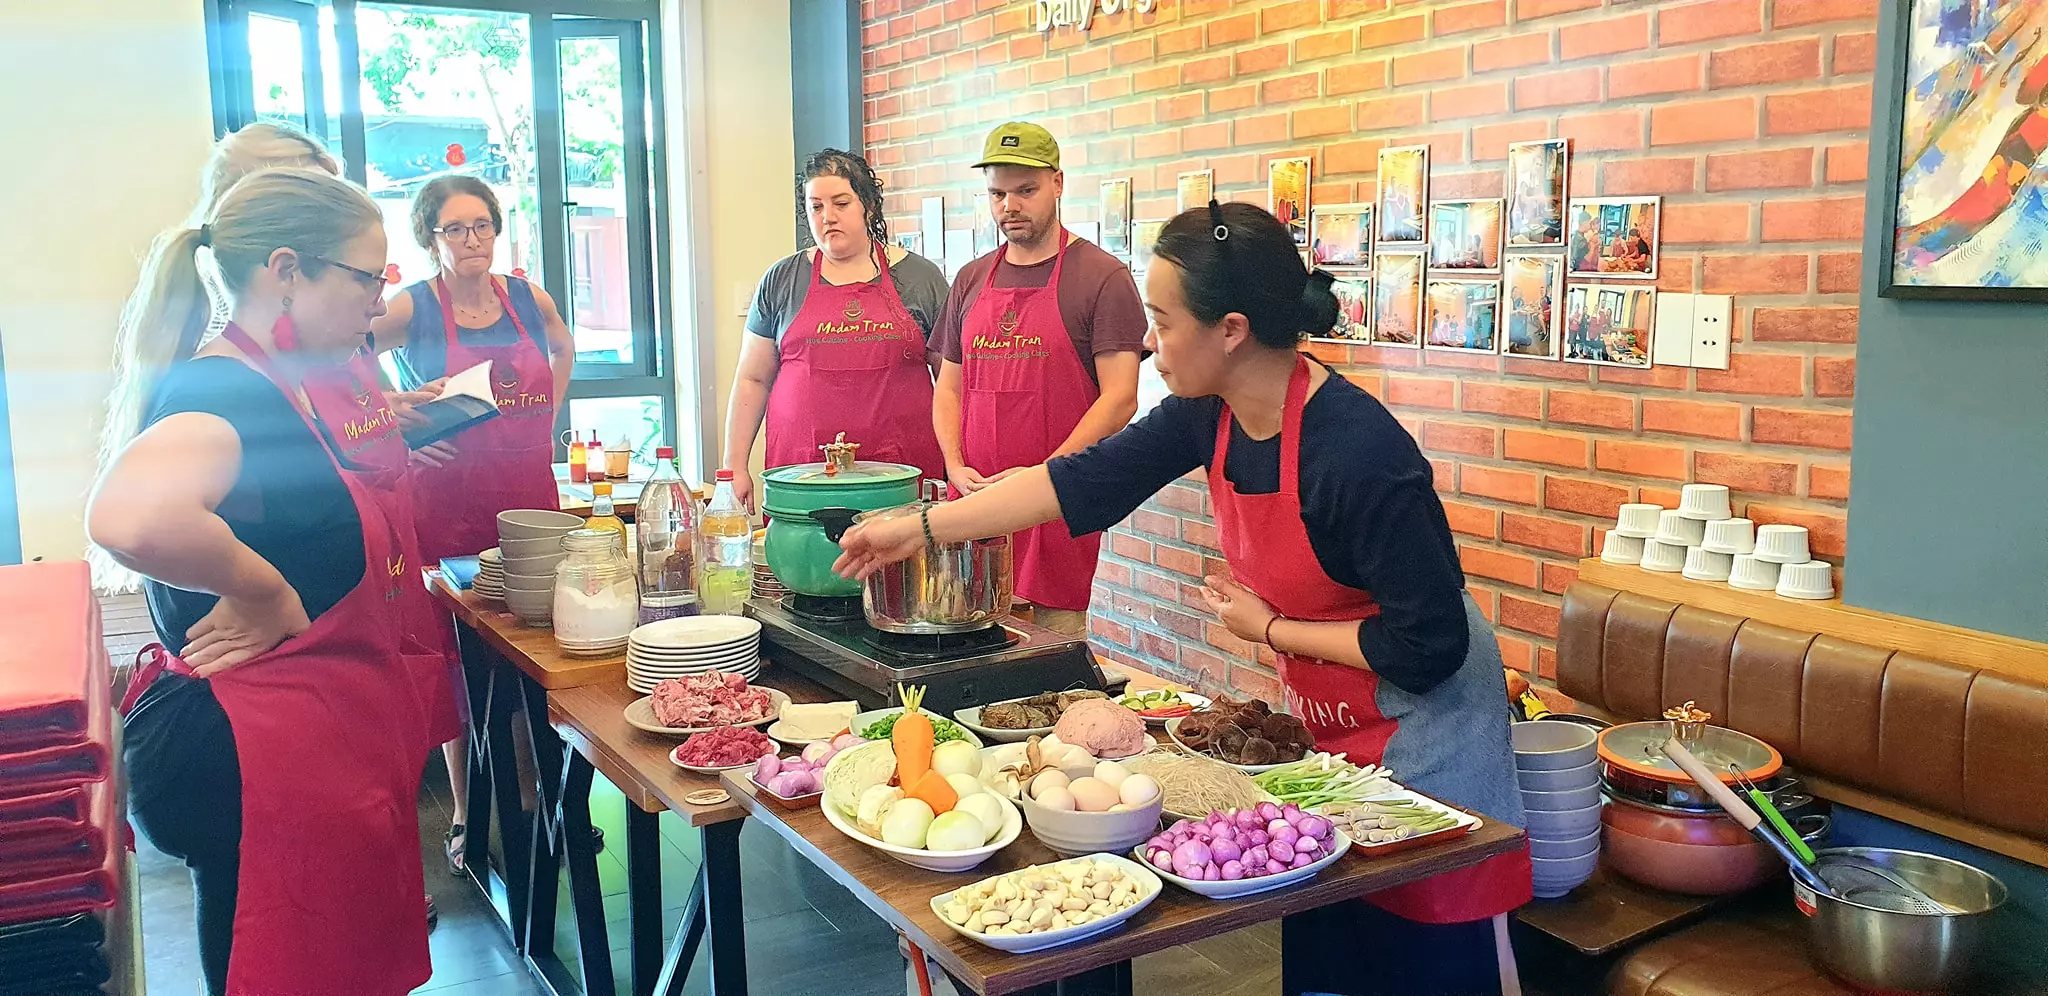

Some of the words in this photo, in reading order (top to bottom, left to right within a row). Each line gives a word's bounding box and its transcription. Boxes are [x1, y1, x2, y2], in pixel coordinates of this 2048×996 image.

[816, 321, 860, 335] Madam
[862, 319, 894, 333] Tran
[972, 335, 1010, 349] Madam
[1013, 335, 1042, 349] Tran
[519, 393, 548, 408] Tran
[344, 415, 381, 441] Madam
